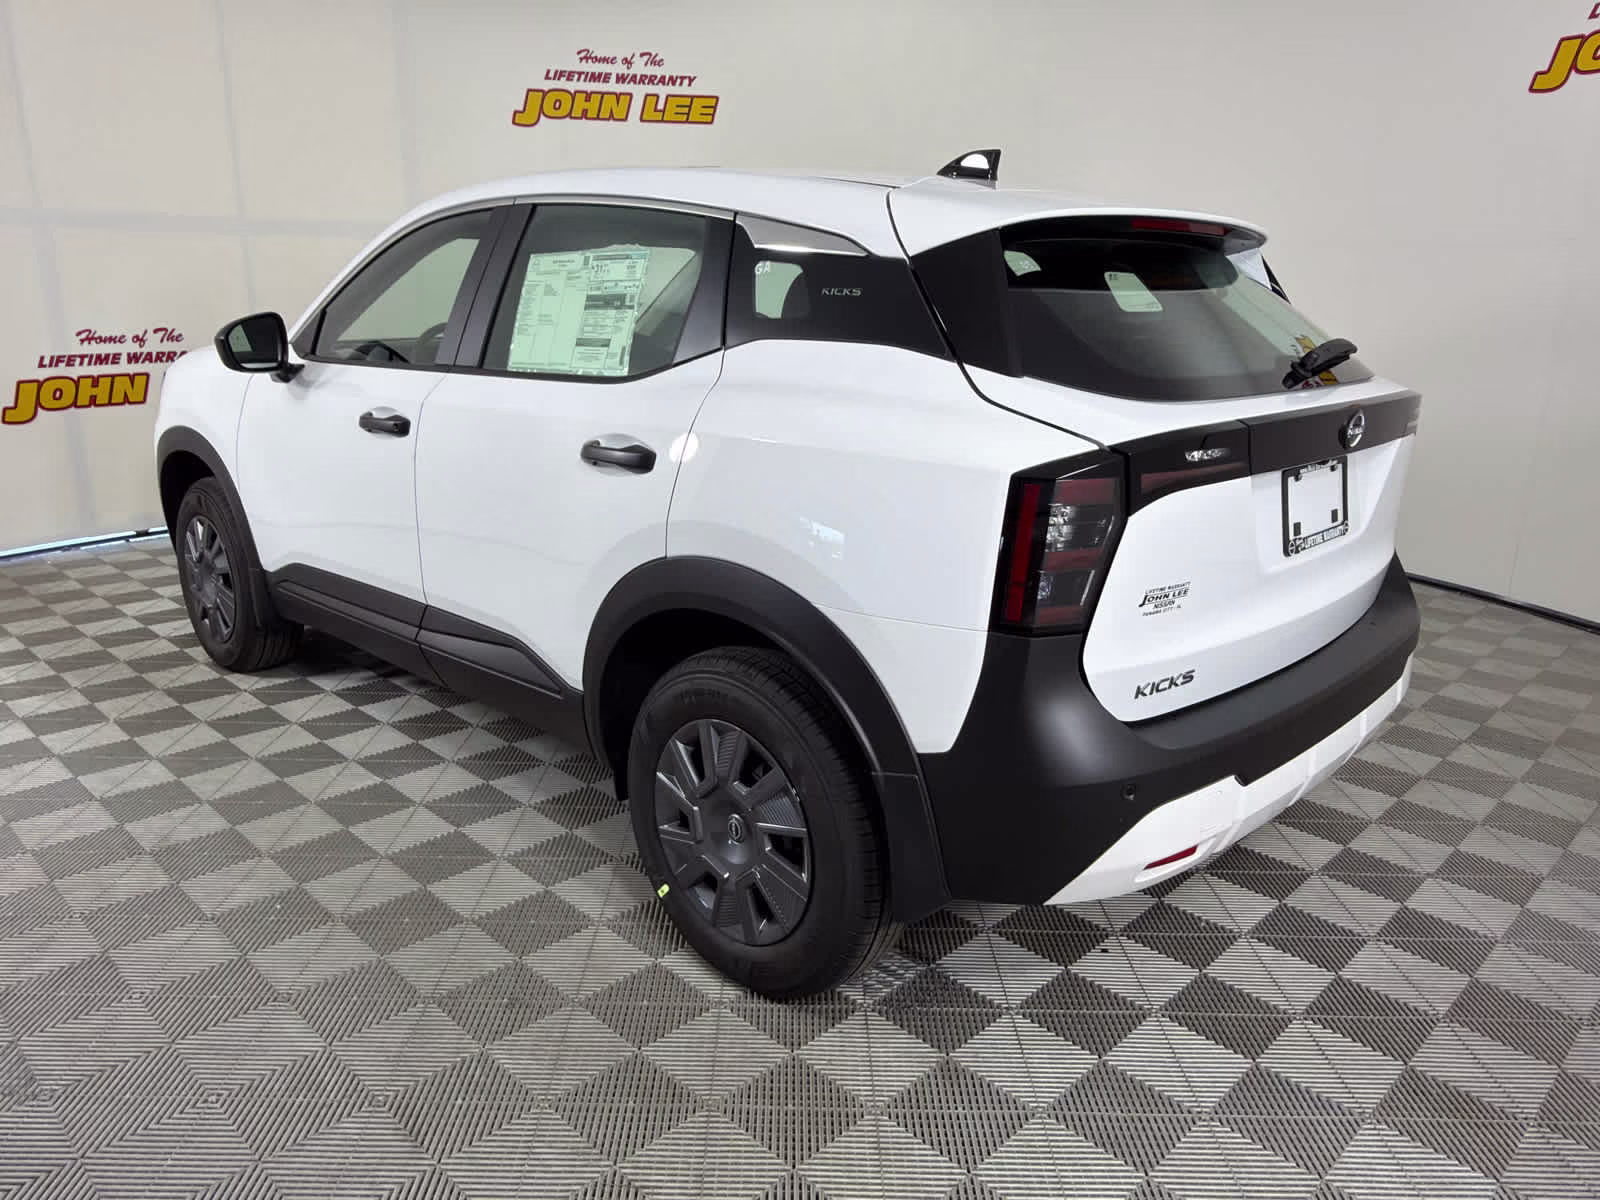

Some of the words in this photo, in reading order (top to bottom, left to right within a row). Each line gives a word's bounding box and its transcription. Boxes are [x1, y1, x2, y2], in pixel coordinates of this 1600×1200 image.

[577, 49, 617, 65] Home
[621, 53, 634, 69] of
[639, 52, 664, 67] The
[544, 69, 612, 83] LIFETIME
[615, 72, 697, 87] WARRANTY
[512, 89, 633, 127] JOHN
[640, 93, 719, 124] LEE
[821, 287, 862, 296] KICKS
[76, 328, 127, 345] Home
[131, 329, 148, 348] of
[152, 327, 184, 343] The
[38, 352, 122, 368] LIFETIME
[2, 372, 150, 424] JOHN
[1138, 592, 1170, 608] JOHN
[1134, 669, 1195, 699] KICKS
